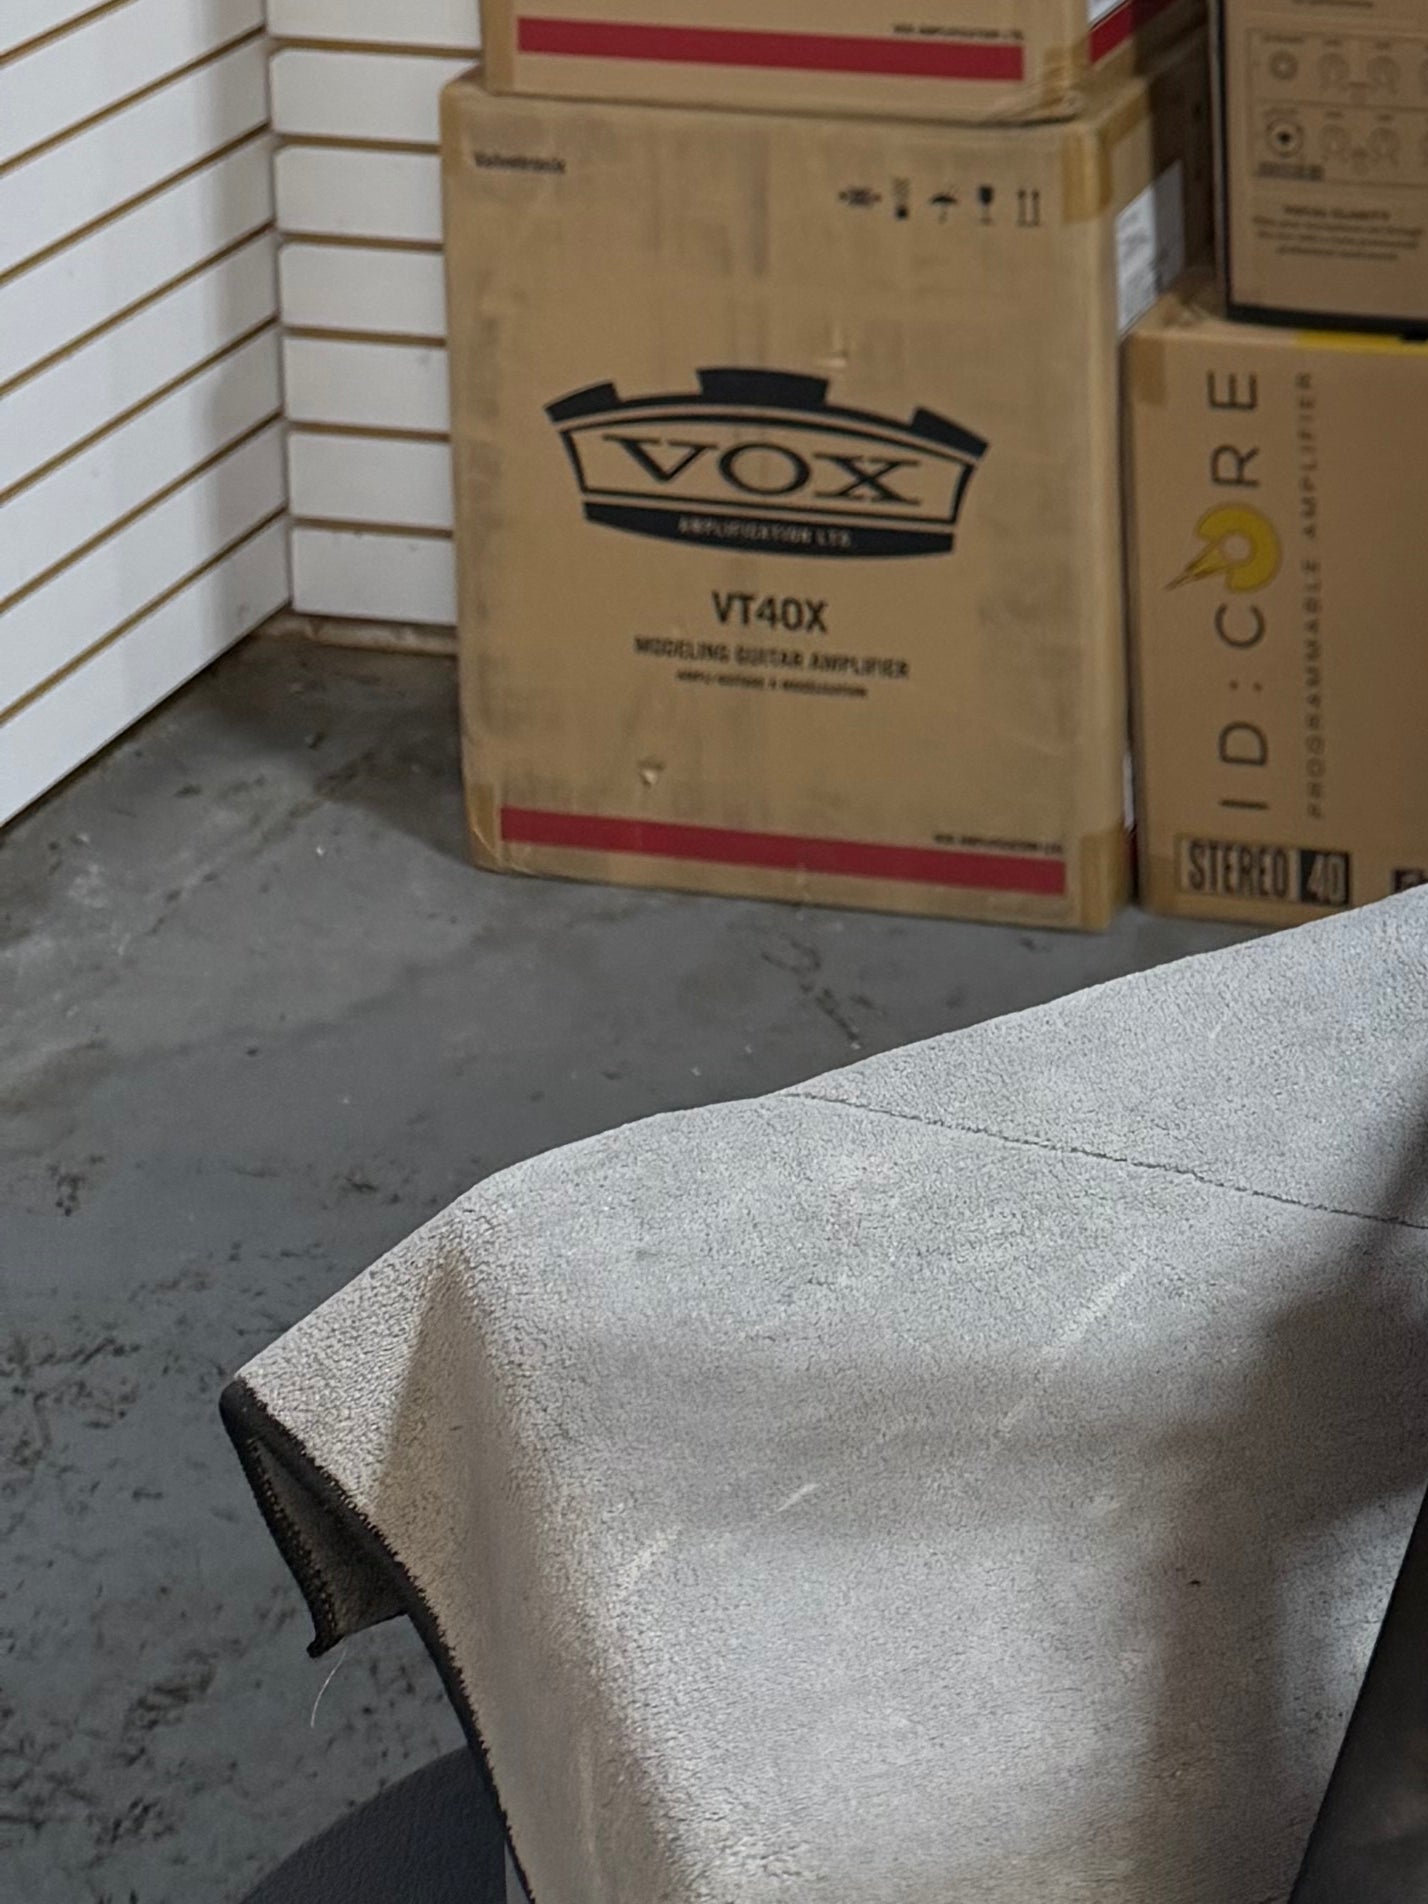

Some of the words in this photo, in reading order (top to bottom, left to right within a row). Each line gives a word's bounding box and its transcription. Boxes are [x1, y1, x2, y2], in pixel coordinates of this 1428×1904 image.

[599, 435, 924, 507] VOX
[1293, 372, 1319, 540] AMPLIFIER
[710, 589, 829, 634] VT40X
[1187, 841, 1290, 900] STEREO
